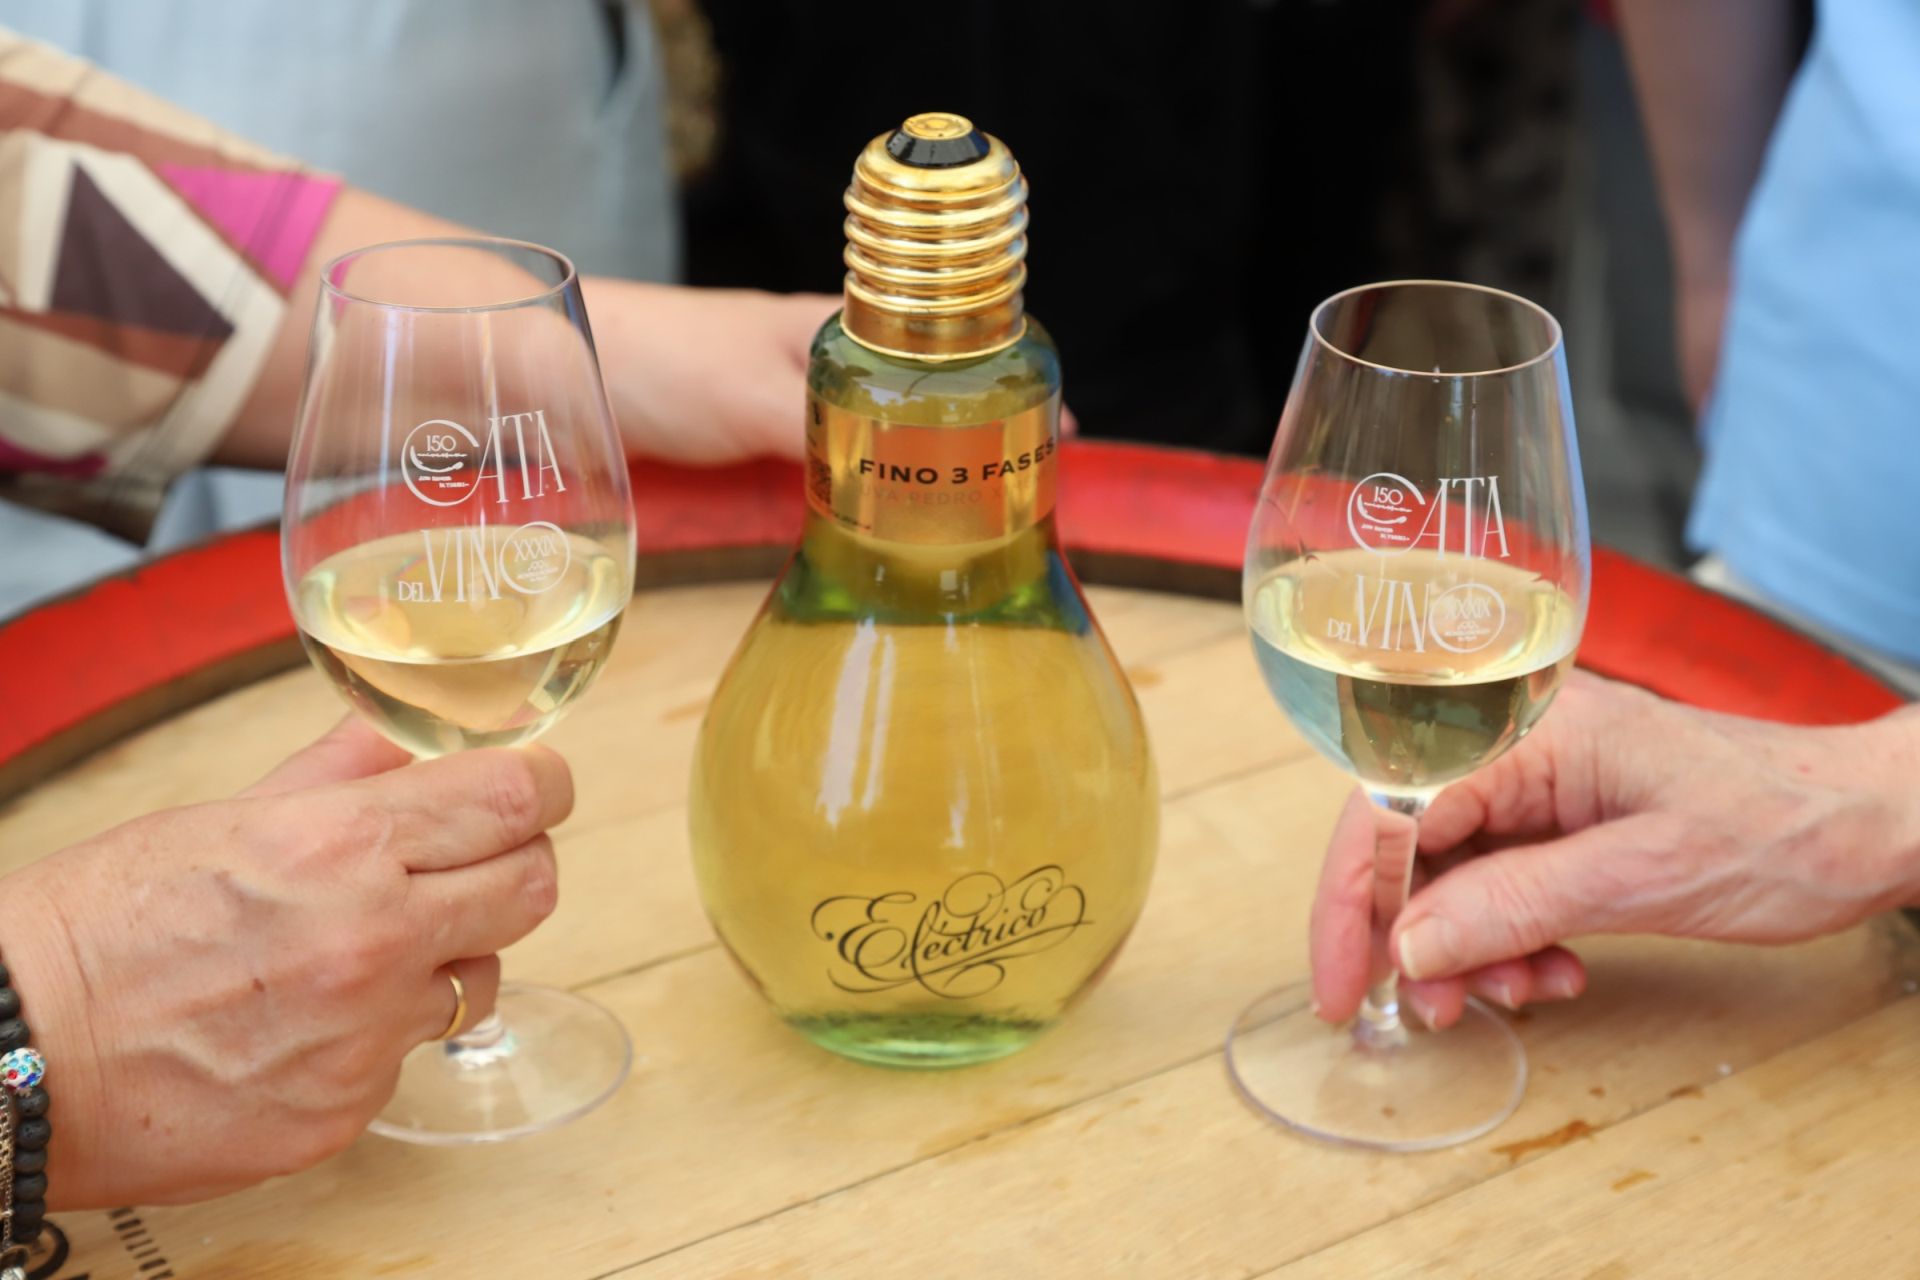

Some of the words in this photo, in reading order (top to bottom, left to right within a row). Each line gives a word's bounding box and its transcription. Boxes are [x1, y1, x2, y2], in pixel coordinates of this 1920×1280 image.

[426, 434, 457, 452] 150
[859, 459, 939, 485] FINO
[951, 467, 969, 484] 3
[982, 436, 1055, 481] FASES
[908, 489, 983, 507] PEDRO
[1374, 486, 1404, 506] 150
[398, 581, 430, 602] DEL
[1327, 618, 1357, 645] DEL
[811, 865, 1095, 999] Eléctrico
